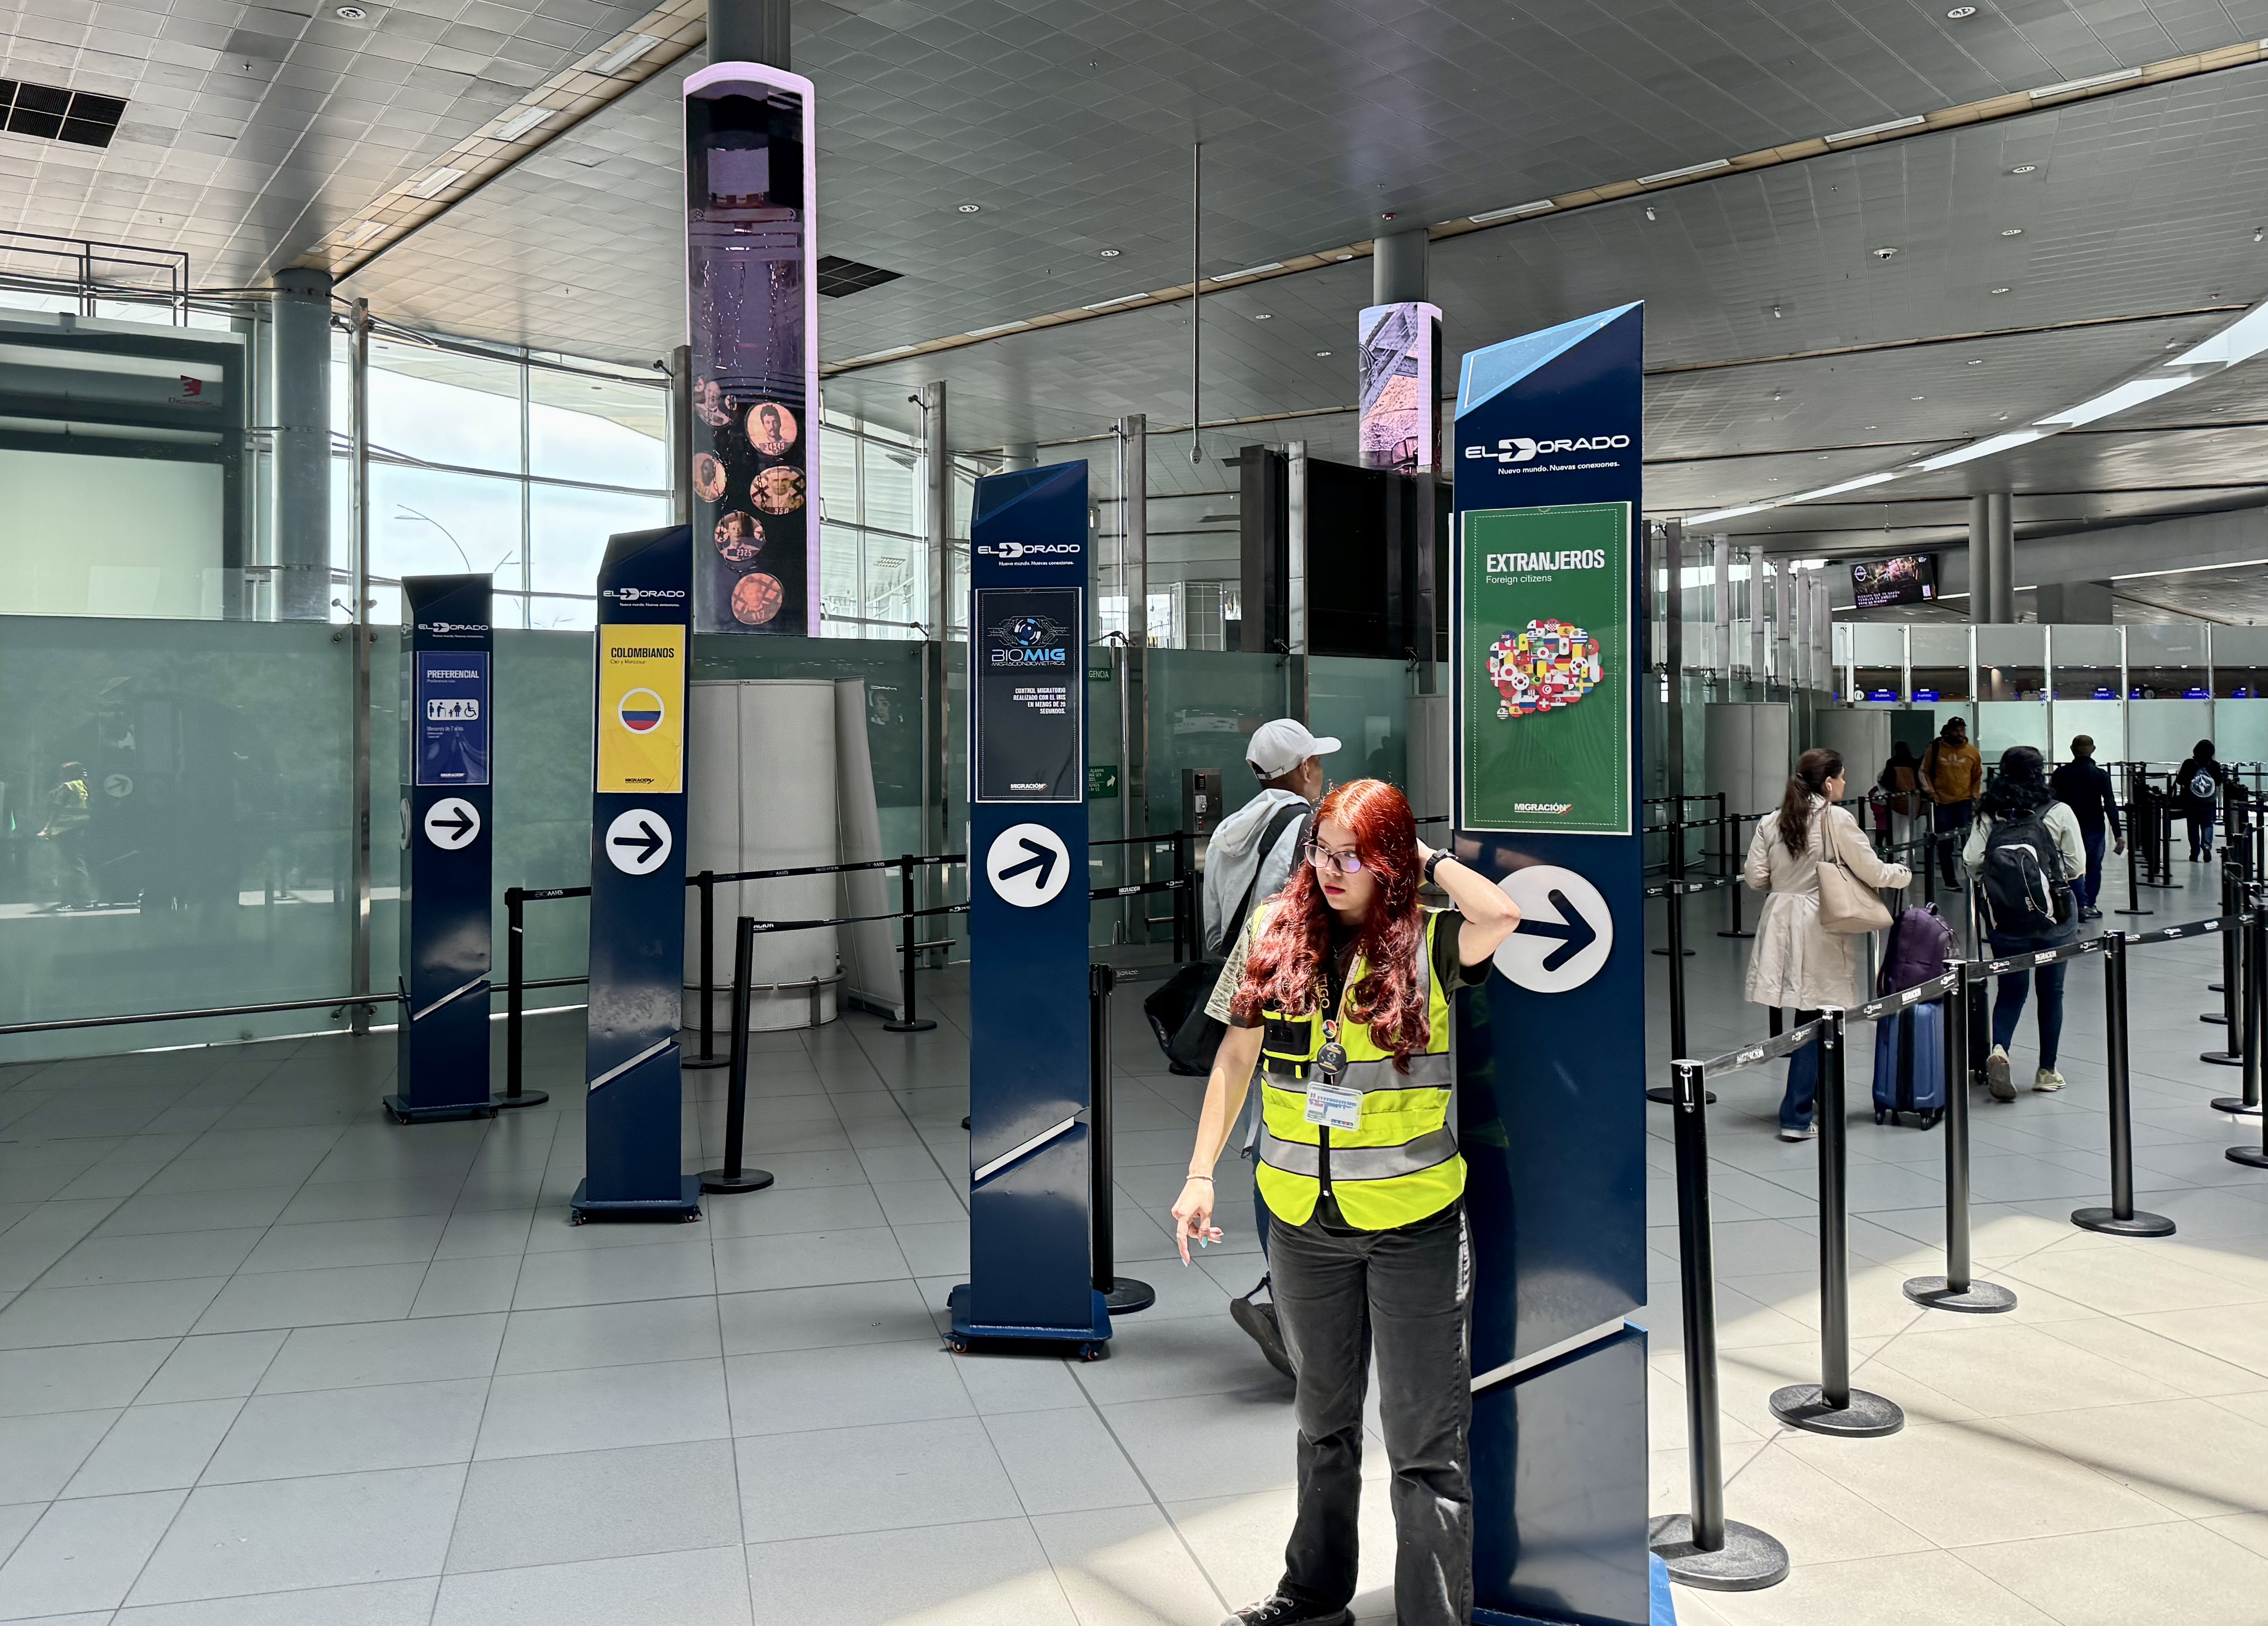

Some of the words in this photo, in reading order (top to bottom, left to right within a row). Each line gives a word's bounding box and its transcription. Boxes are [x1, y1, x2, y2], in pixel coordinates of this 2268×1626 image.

[1465, 446, 1499, 459] EL
[1498, 435, 1631, 463] DORADO
[1522, 465, 1549, 473] mundo.
[1577, 461, 1620, 470] conexiones.
[977, 546, 999, 554] EL
[999, 542, 1081, 558] DORADO
[1486, 549, 1605, 573] EXTRANJEROS
[1486, 575, 1518, 585] Foreign
[1520, 574, 1552, 583] citizens
[620, 587, 685, 601] DORADO
[433, 622, 489, 633] DORADO
[611, 647, 675, 658] COLOMBIANOS
[991, 648, 1065, 662] BIOMIG
[427, 670, 480, 678] PREFERENCIAL
[1514, 802, 1568, 812] MIGRACIÓN
